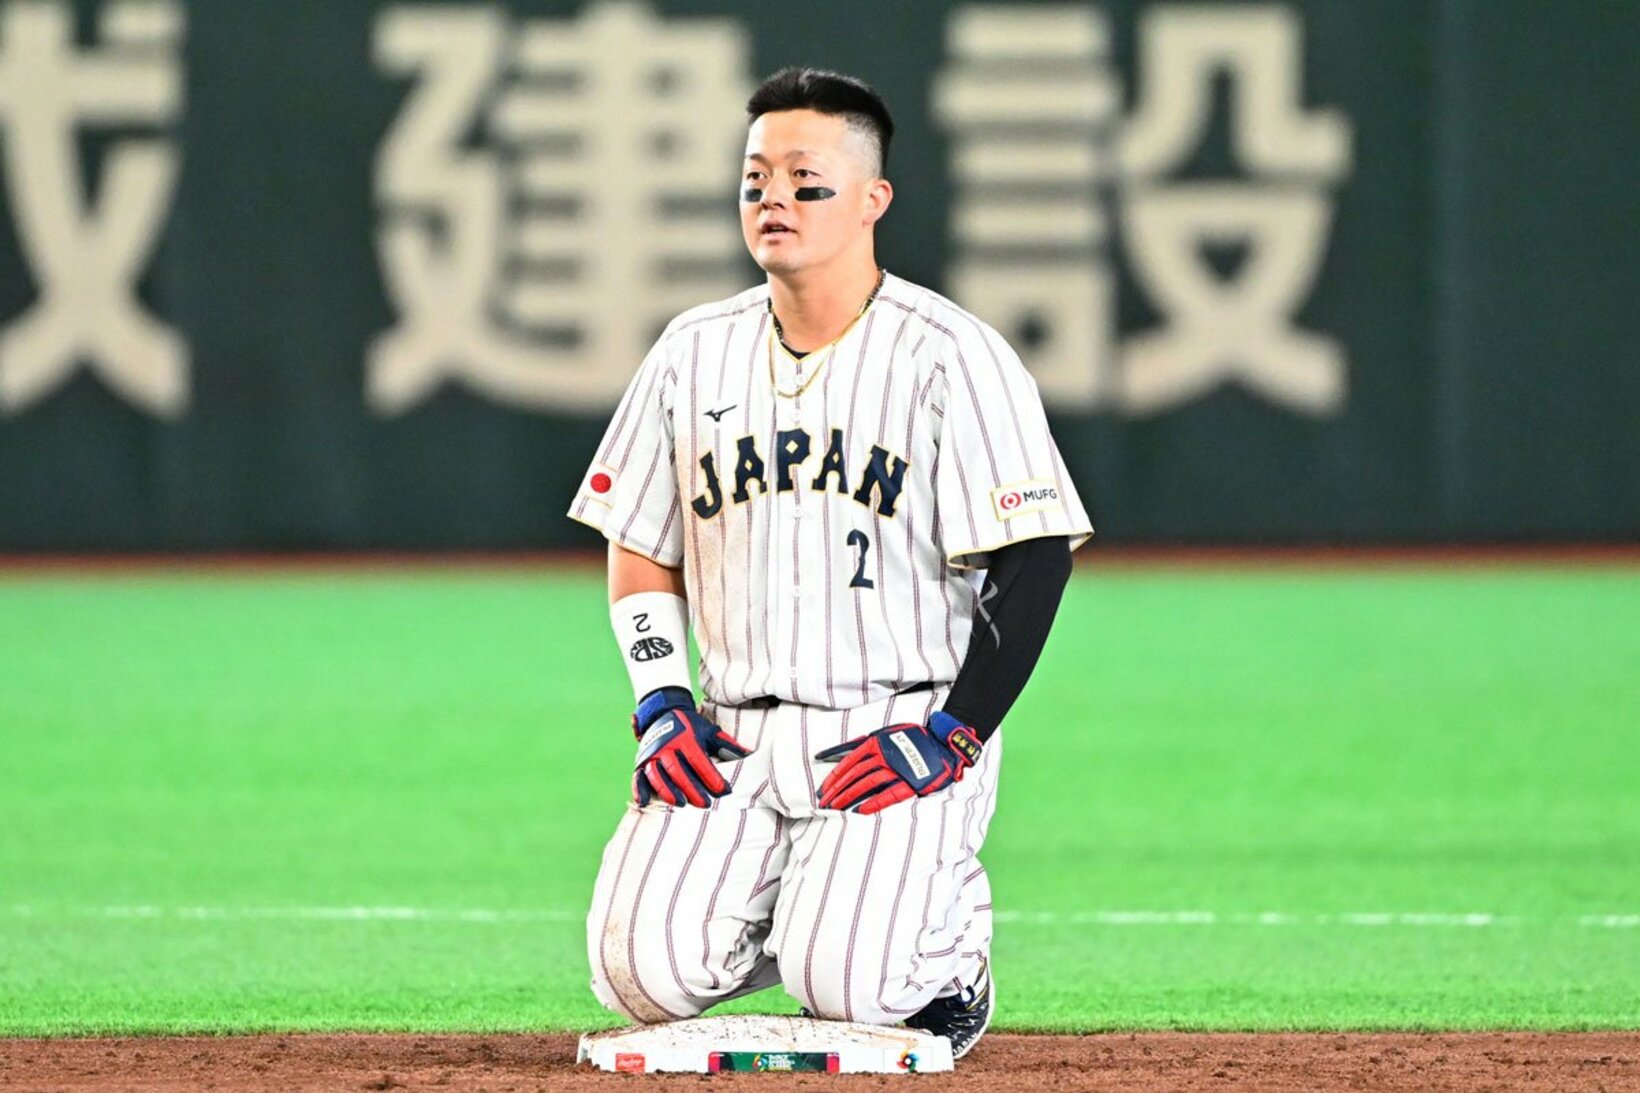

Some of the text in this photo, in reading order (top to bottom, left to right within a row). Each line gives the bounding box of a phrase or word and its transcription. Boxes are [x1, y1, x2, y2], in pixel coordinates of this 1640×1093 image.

[690, 427, 911, 521] JAPAN
[1023, 488, 1057, 502] MUFG
[847, 528, 874, 590] 2
[632, 613, 651, 634] 2
